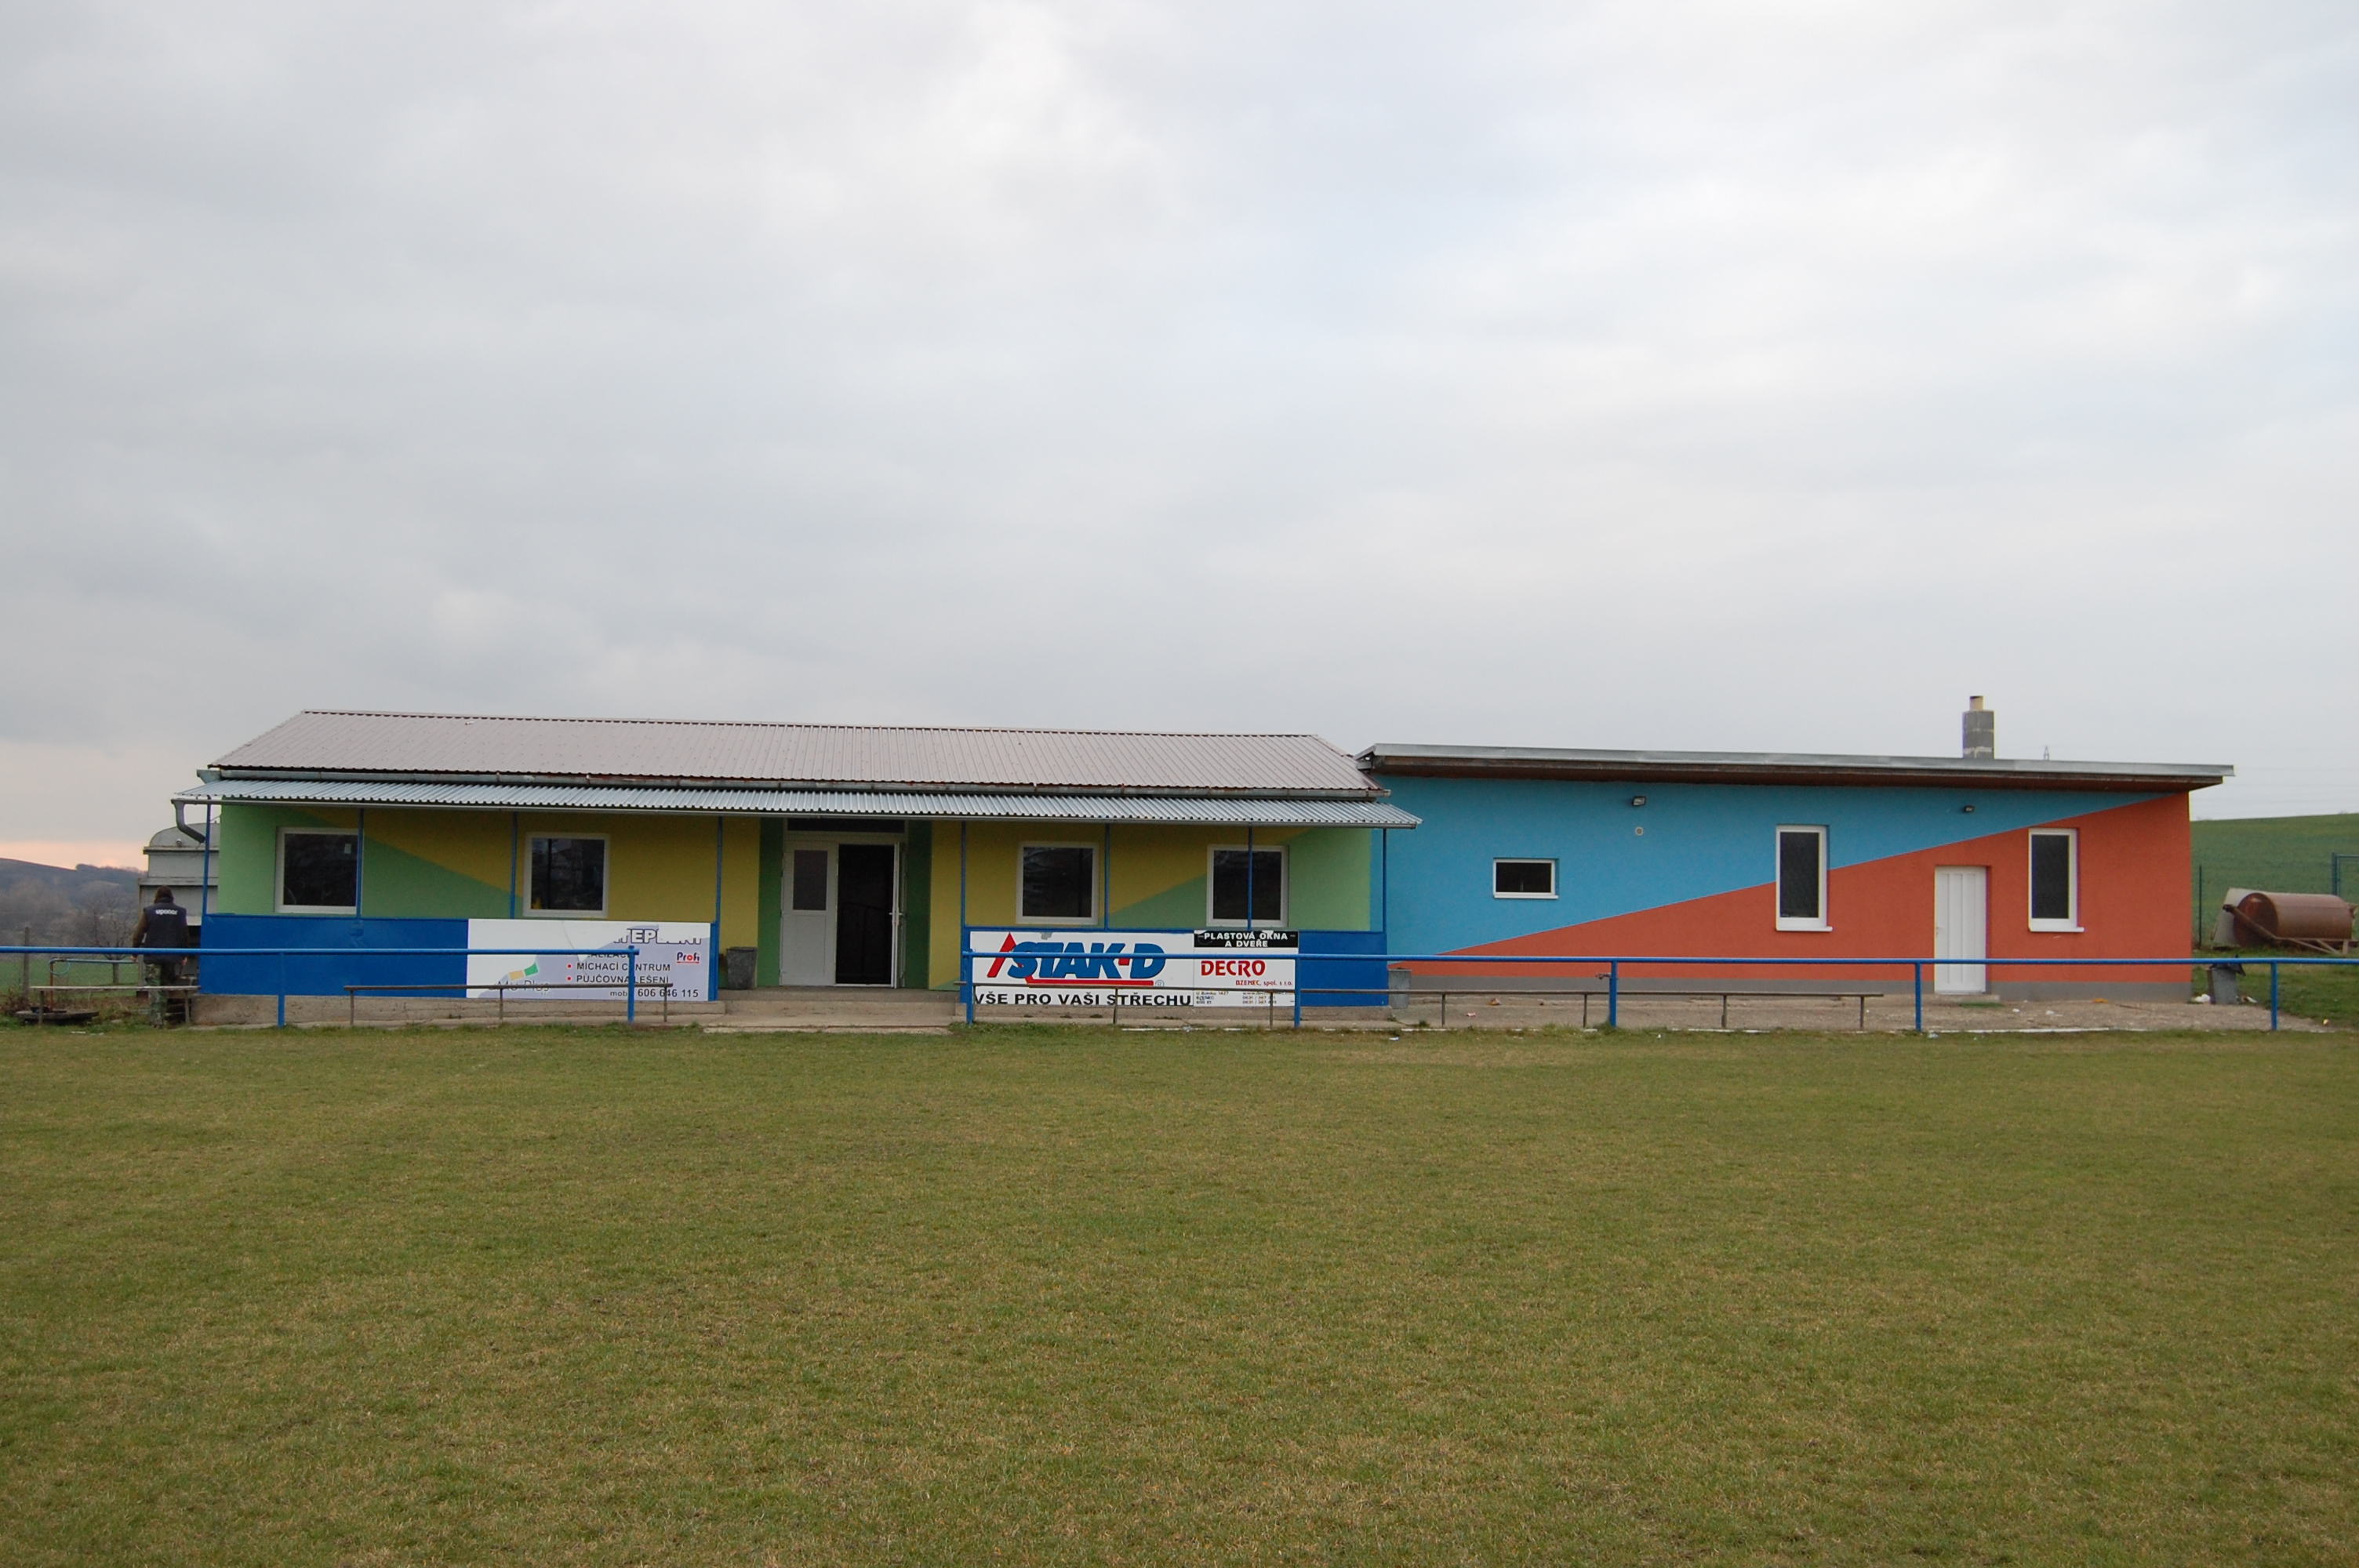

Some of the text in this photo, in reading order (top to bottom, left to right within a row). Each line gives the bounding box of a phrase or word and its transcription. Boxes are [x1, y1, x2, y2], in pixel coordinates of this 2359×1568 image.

[1204, 931, 1256, 940] PLASTOVÁ
[677, 952, 700, 962] Profi
[622, 963, 671, 971] CNTRUM
[1201, 960, 1266, 978] DECRO
[638, 989, 656, 997] 606
[682, 989, 699, 998] 115
[975, 991, 1191, 1006] VŠE PRO VAŠI STŘECHU
